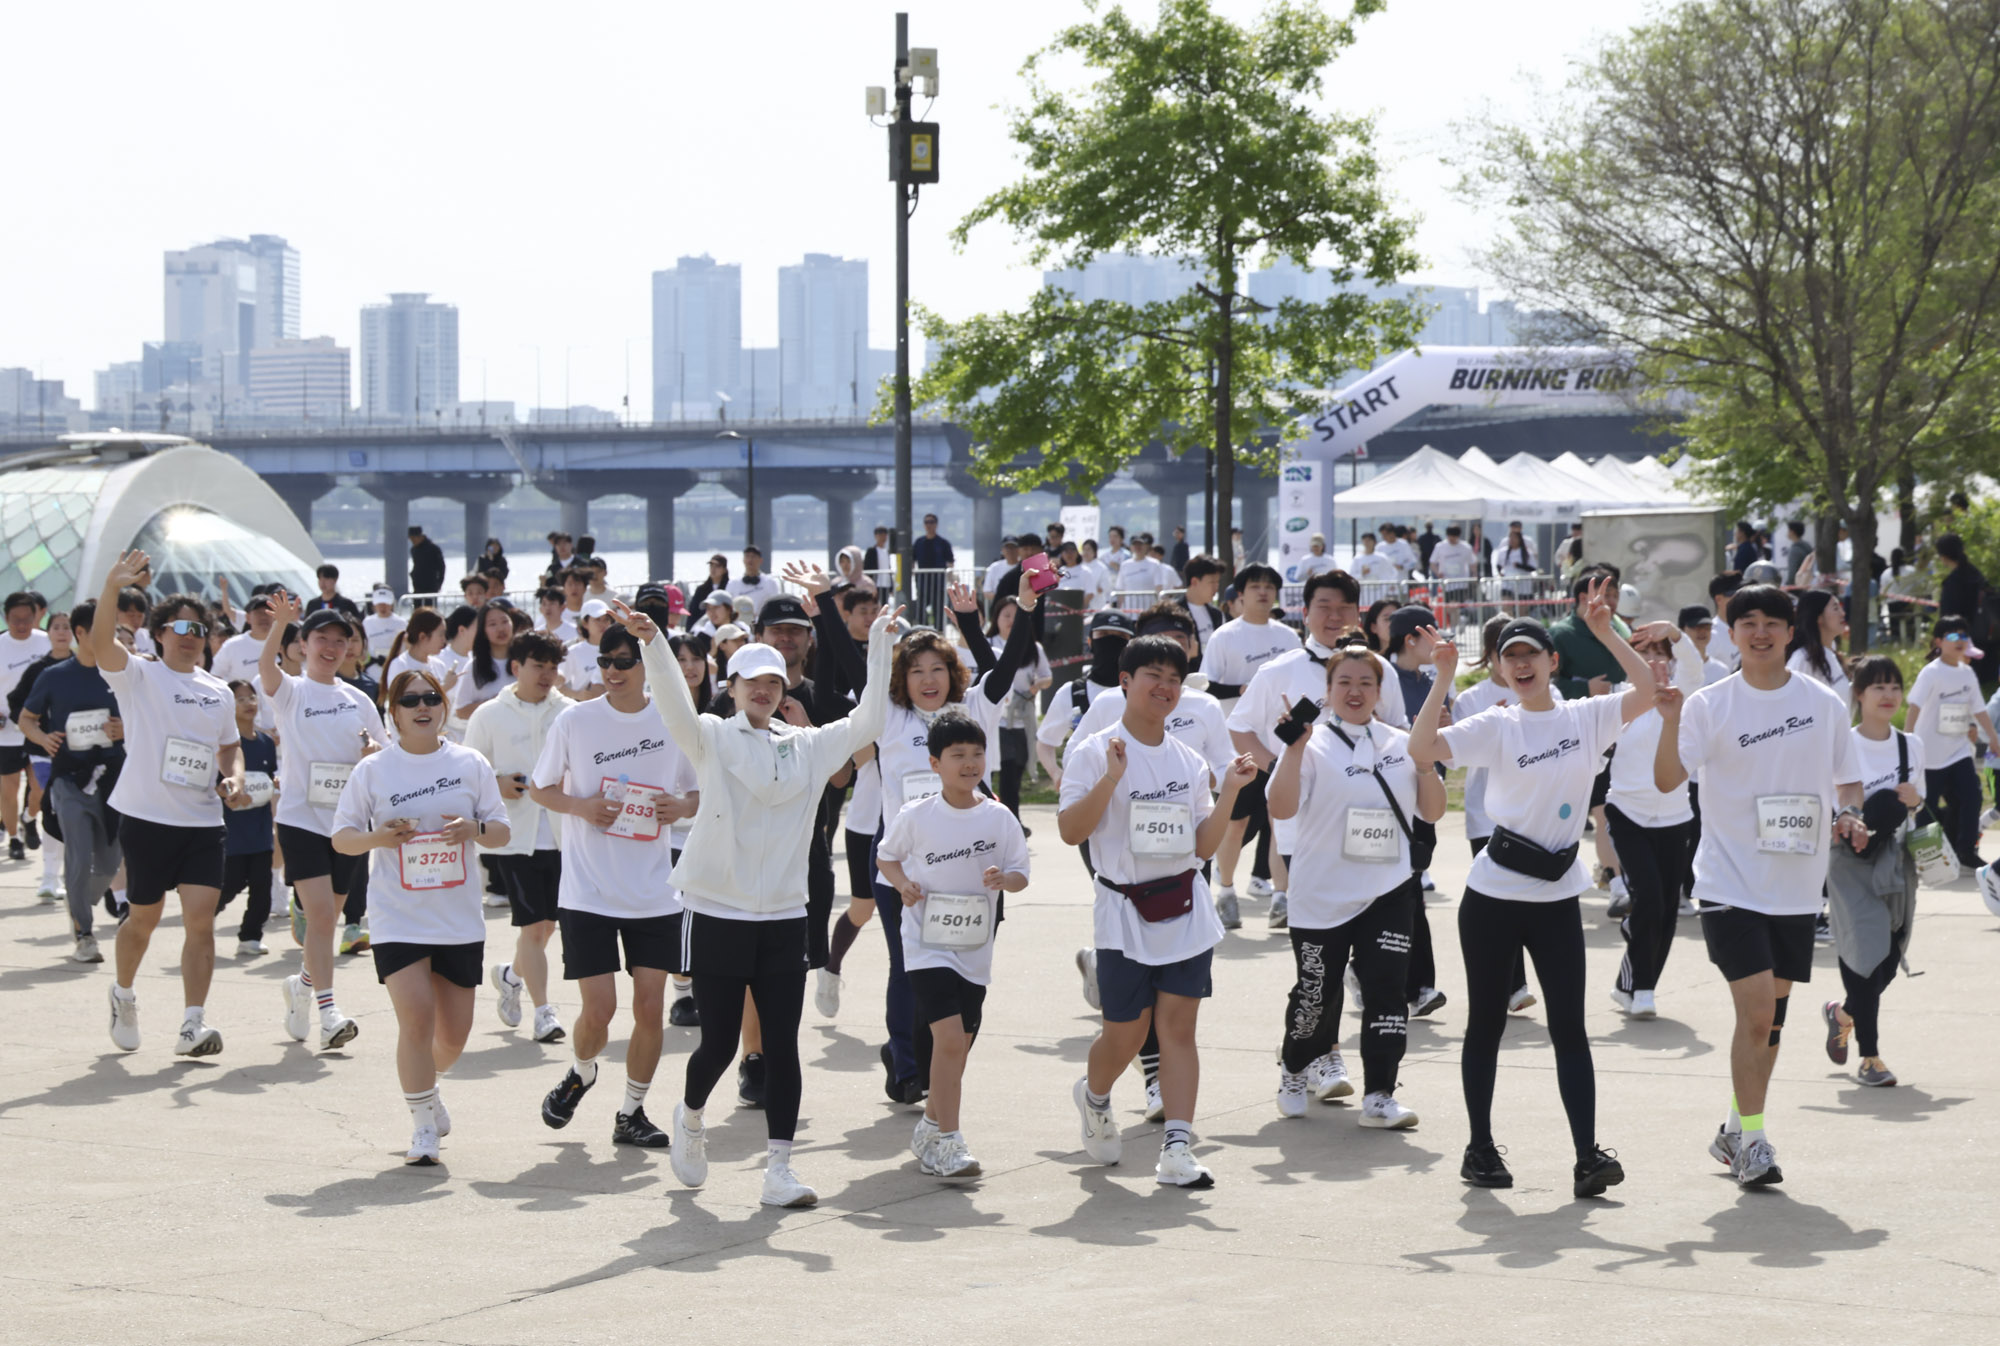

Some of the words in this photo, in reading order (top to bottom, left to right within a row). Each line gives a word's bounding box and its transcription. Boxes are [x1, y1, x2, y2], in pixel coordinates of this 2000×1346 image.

[1449, 368, 1569, 390] BURNING
[1313, 376, 1401, 442] START
[304, 707, 338, 718] Burning
[338, 703, 357, 711] Run
[1171, 717, 1195, 729] Run
[1738, 726, 1785, 748] Burning
[1785, 716, 1814, 732] Run
[593, 747, 638, 765] Burning
[639, 739, 665, 752] Run
[1517, 748, 1560, 768] Burning
[1558, 739, 1580, 752] Run
[178, 756, 207, 771] 5124
[1383, 755, 1405, 765] Run
[389, 785, 436, 807] Burning
[436, 777, 462, 790] Run
[1166, 781, 1190, 794] Run
[1135, 823, 1145, 831] M
[1147, 822, 1184, 835] 5011
[1766, 818, 1776, 827] M
[1779, 816, 1813, 828] 5060
[1351, 828, 1361, 836] W
[1363, 828, 1394, 839] 6041
[408, 856, 417, 864] W
[419, 851, 457, 865] 3720
[925, 848, 972, 865] Burning
[972, 840, 997, 853] Run
[930, 914, 940, 922] M
[942, 914, 983, 926] 5014
